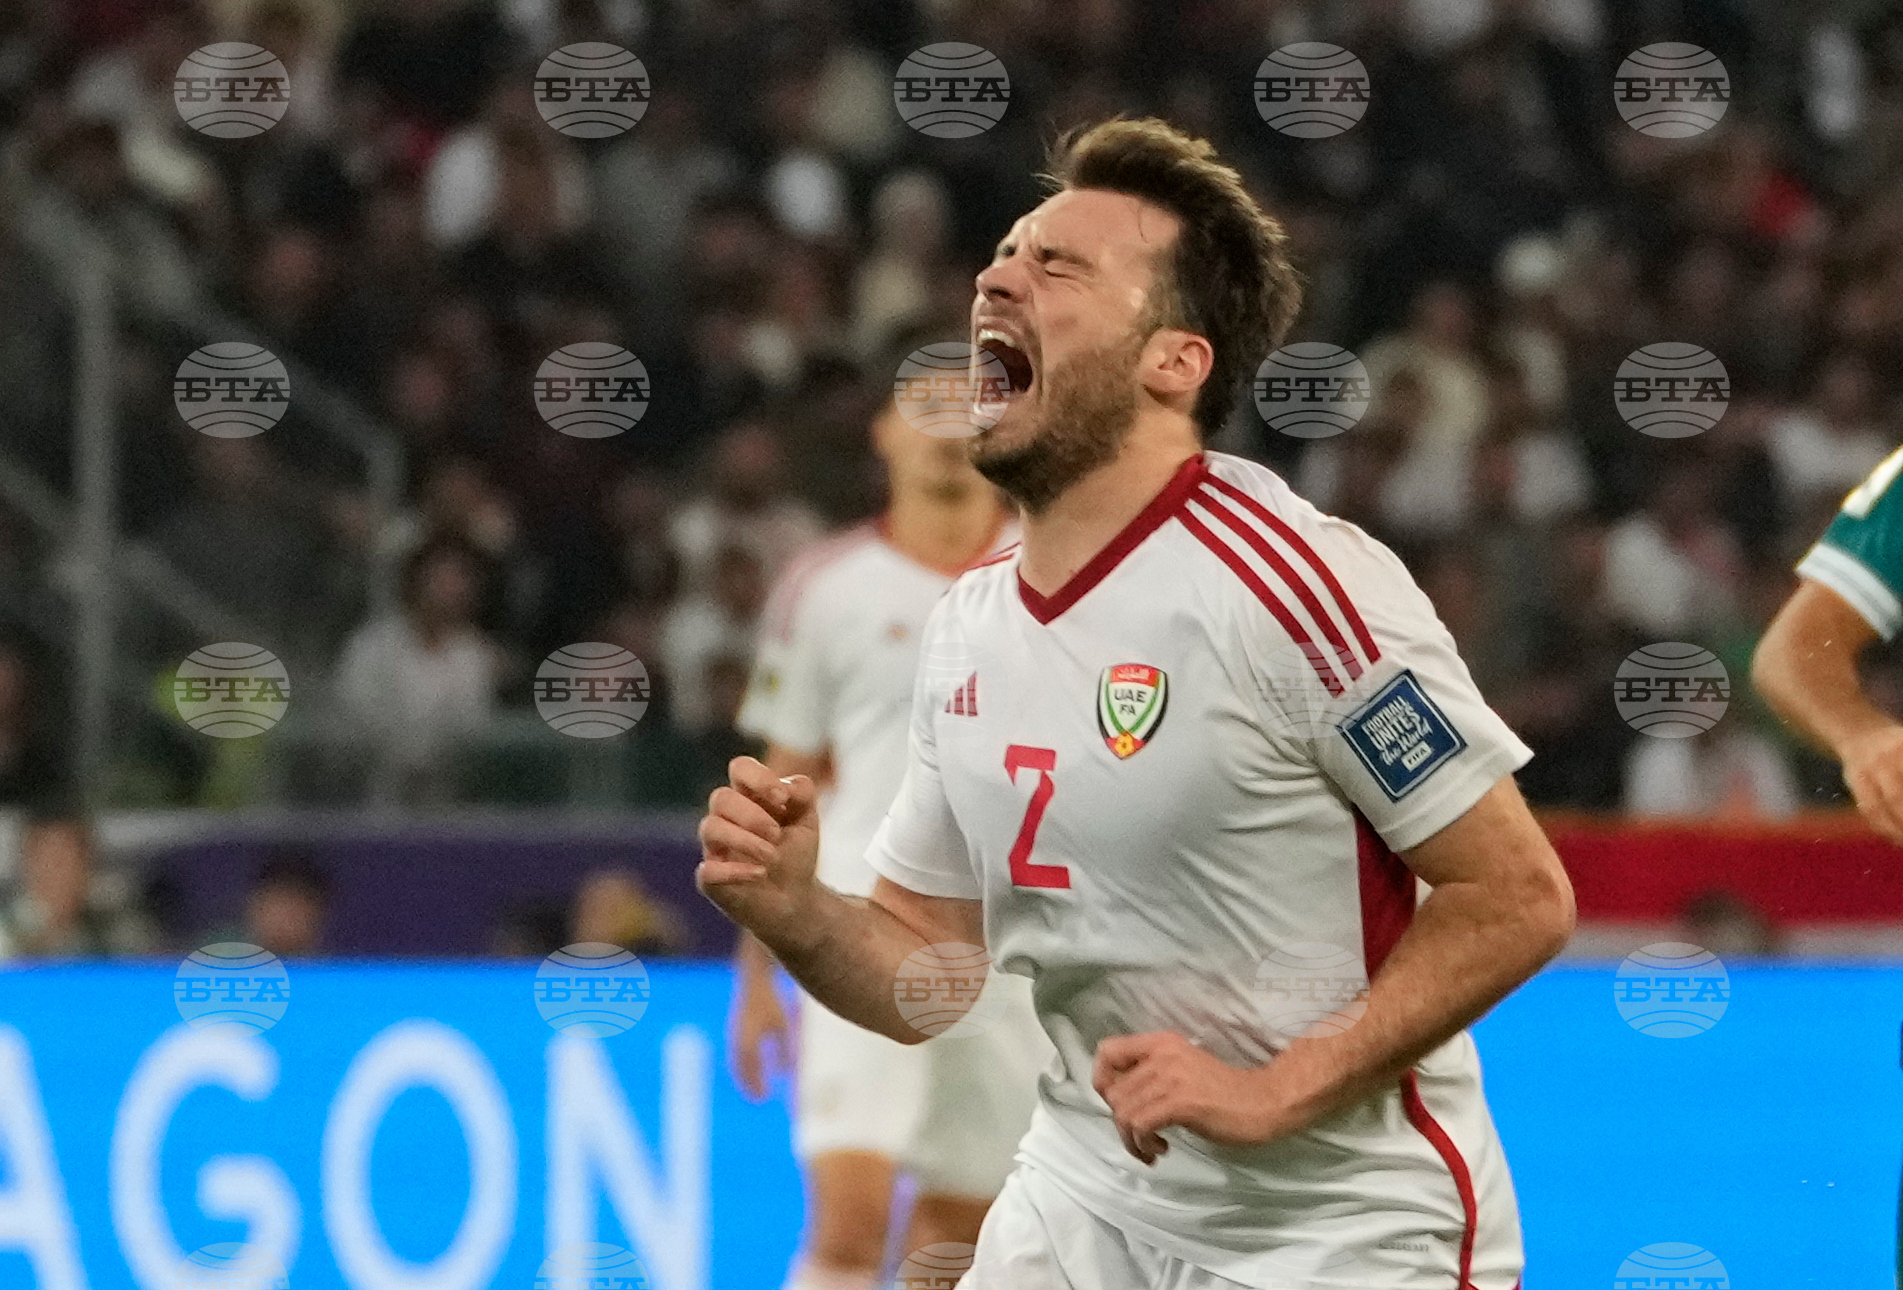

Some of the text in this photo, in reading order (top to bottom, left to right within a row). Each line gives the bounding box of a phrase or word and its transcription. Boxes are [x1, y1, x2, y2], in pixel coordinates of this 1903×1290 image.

[1114, 689, 1147, 703] UAE
[1368, 701, 1421, 750] UNITES
[1004, 745, 1071, 889] 2
